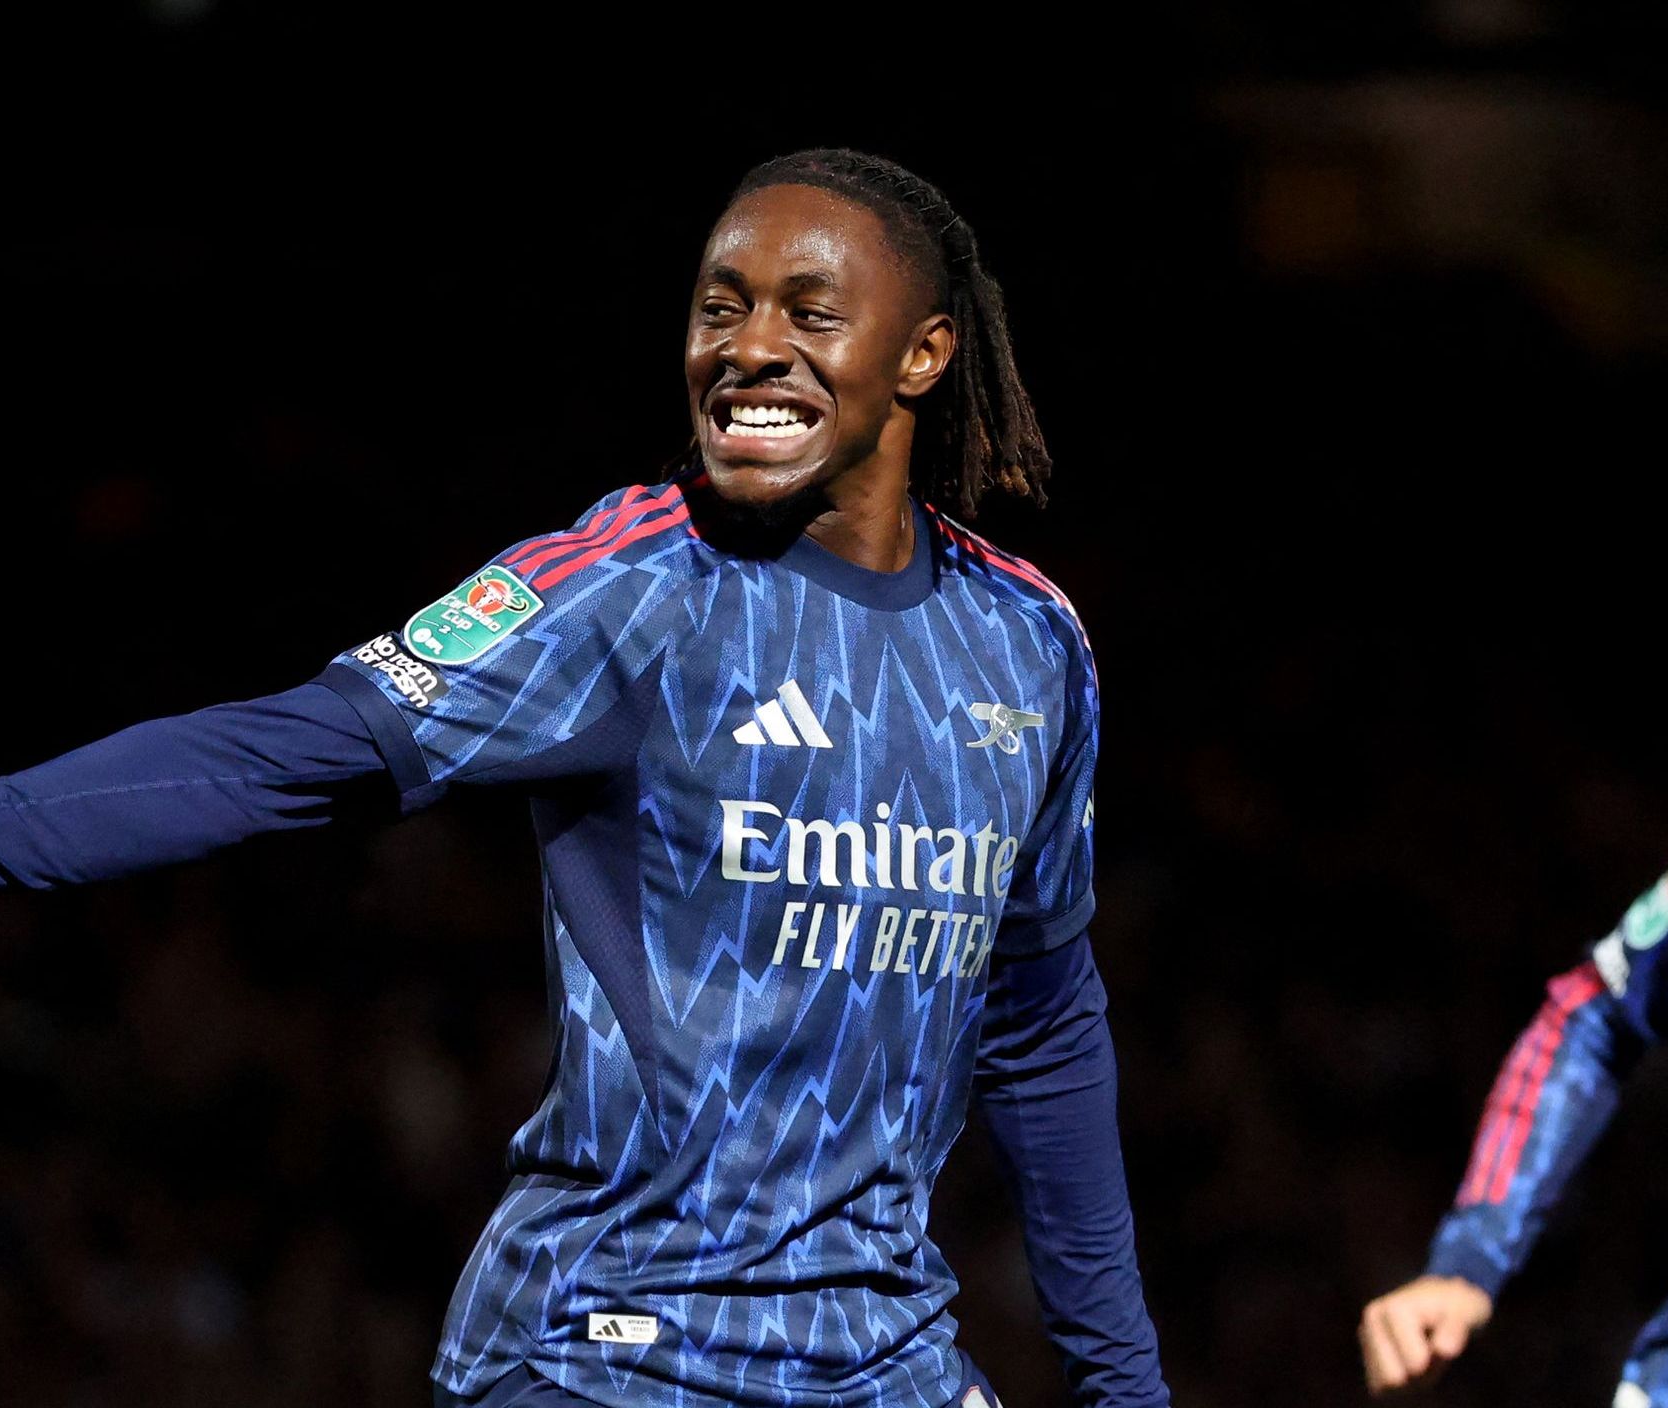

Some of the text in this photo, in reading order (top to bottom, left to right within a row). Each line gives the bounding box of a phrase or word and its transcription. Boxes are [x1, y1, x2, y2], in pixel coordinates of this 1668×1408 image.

[440, 594, 502, 633] Carabao
[441, 609, 474, 631] Cup
[368, 633, 439, 693] No room
[372, 660, 429, 708] racism
[771, 901, 863, 971] FLY
